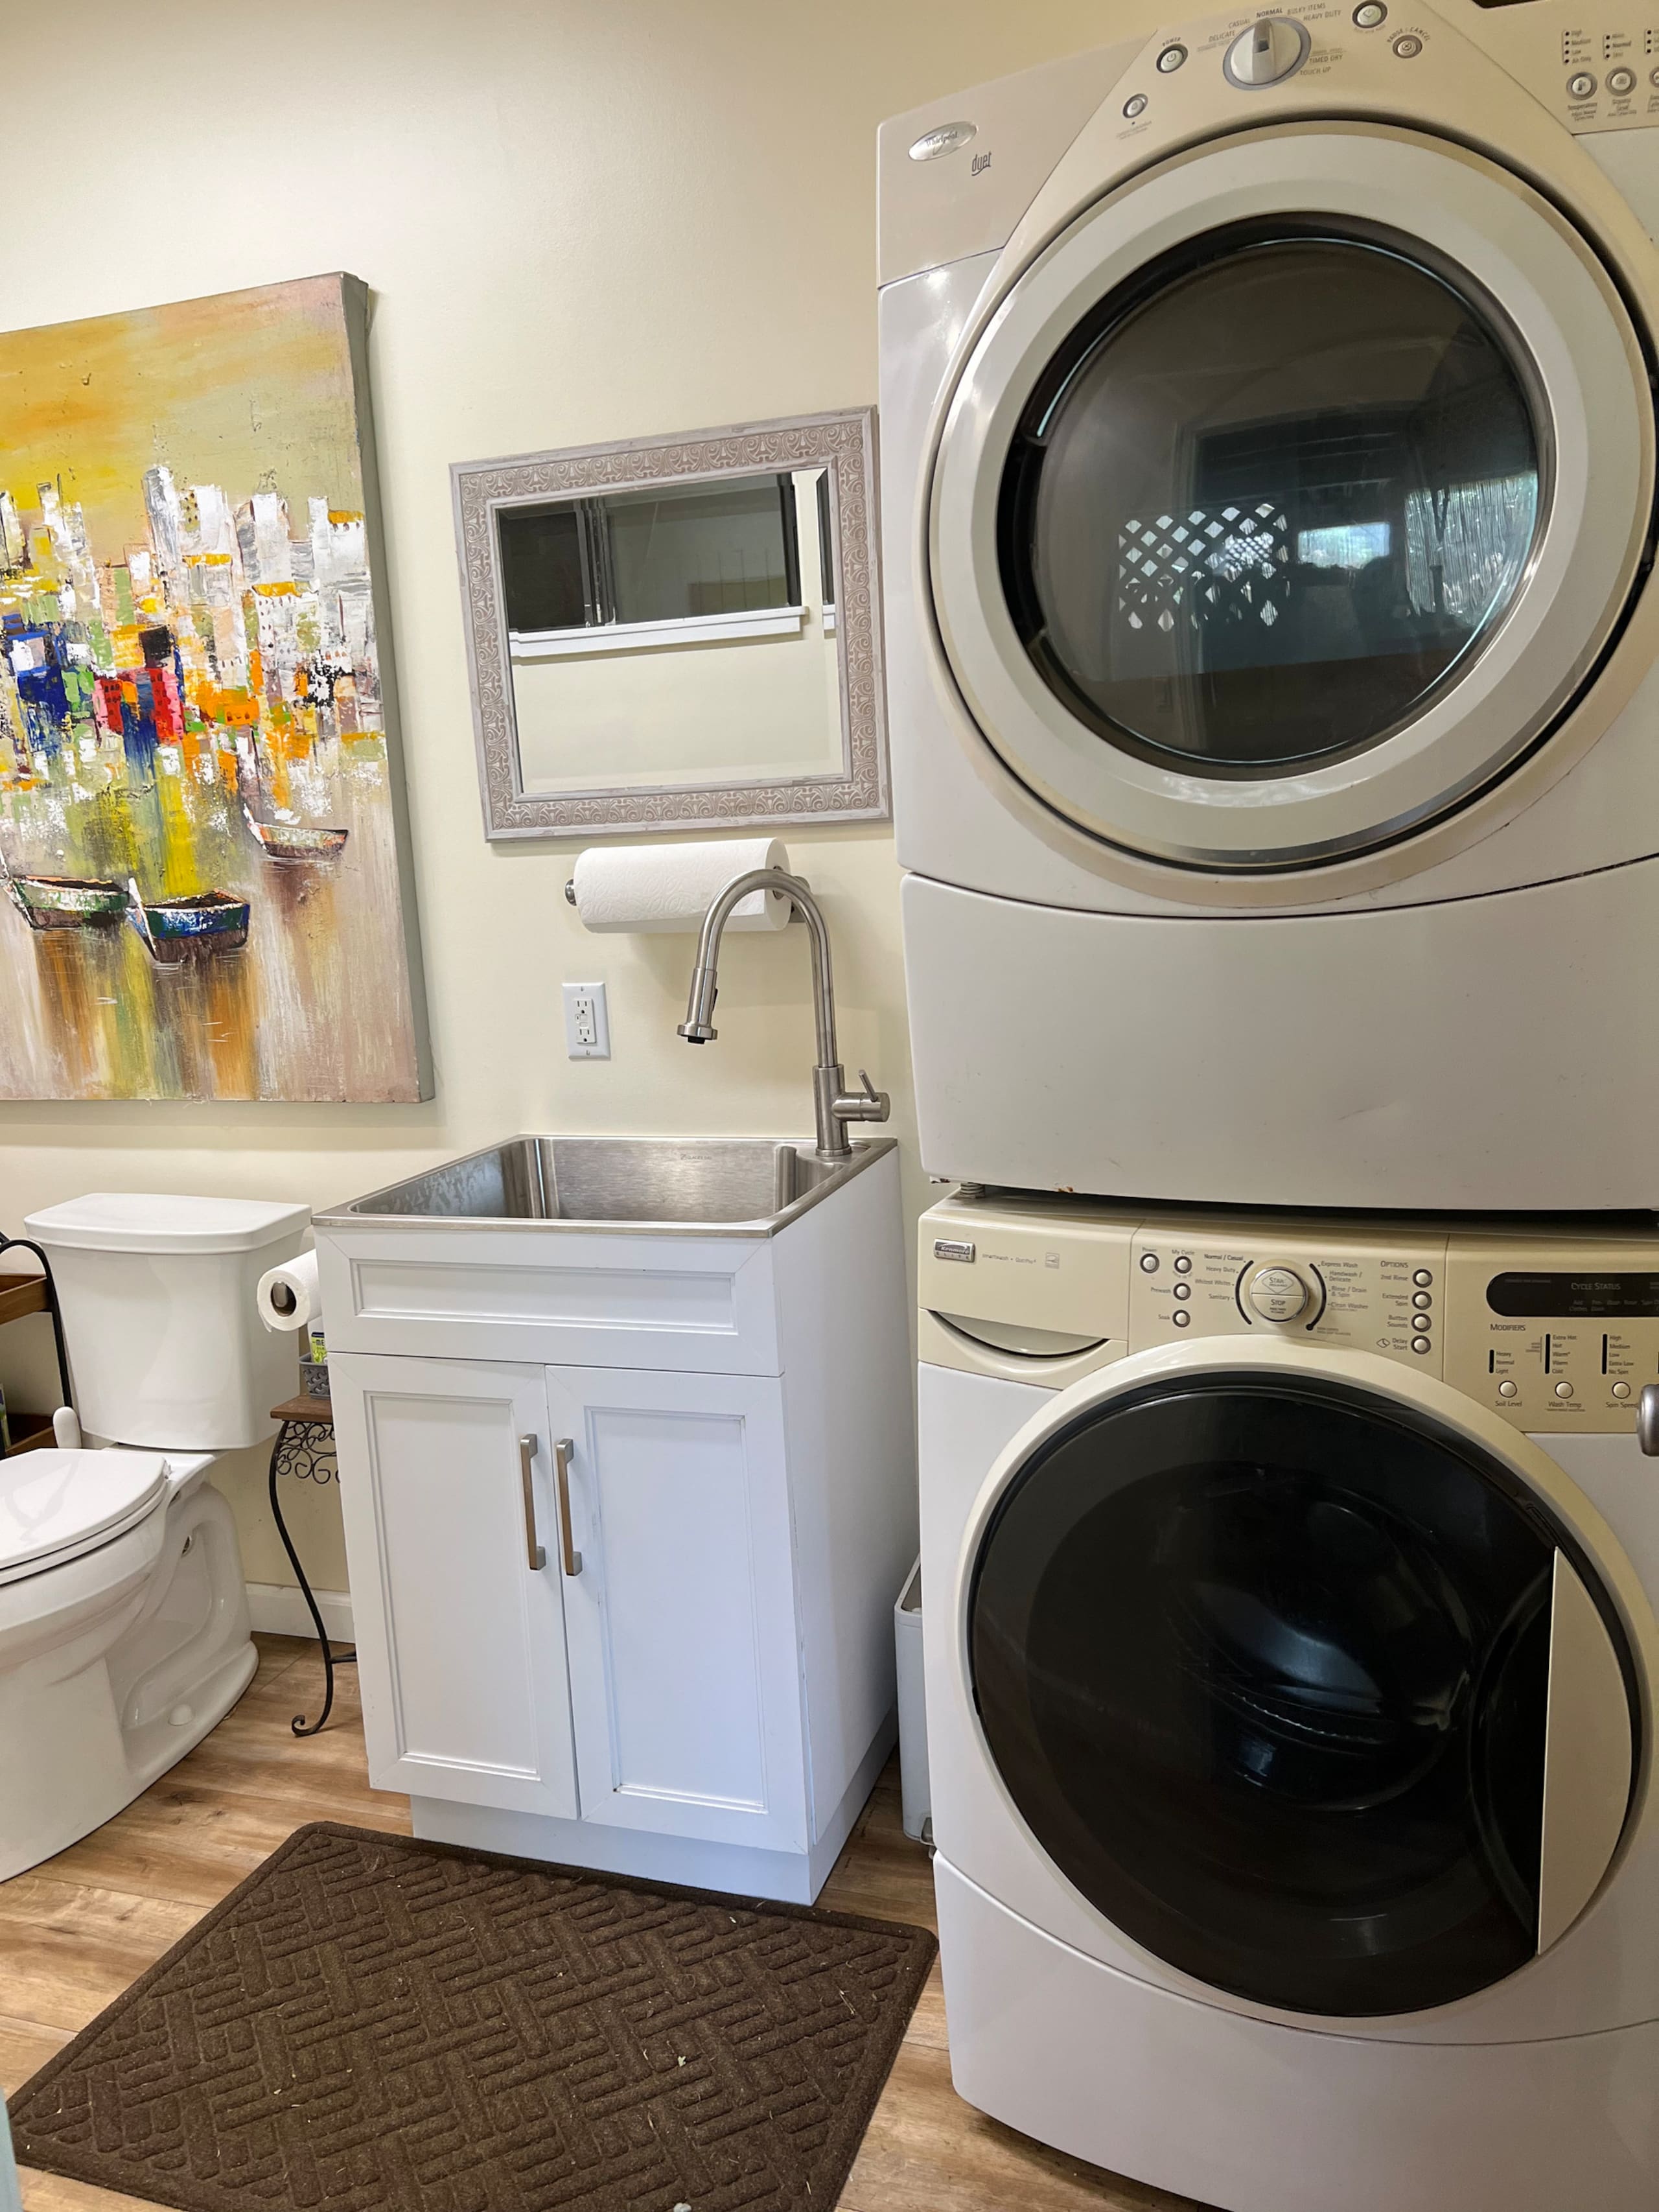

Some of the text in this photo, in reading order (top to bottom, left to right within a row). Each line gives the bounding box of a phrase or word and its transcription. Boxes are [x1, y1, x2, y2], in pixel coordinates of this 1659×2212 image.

[1256, 7, 1283, 18] NORMAL
[1308, 3, 1326, 11] ITEMS
[1303, 10, 1342, 21] HEAVY DUTY
[1228, 18, 1251, 29] CASUAL
[1209, 30, 1235, 42] DELICATE
[971, 151, 992, 176] duet
[940, 1245, 969, 1255] Kenmore
